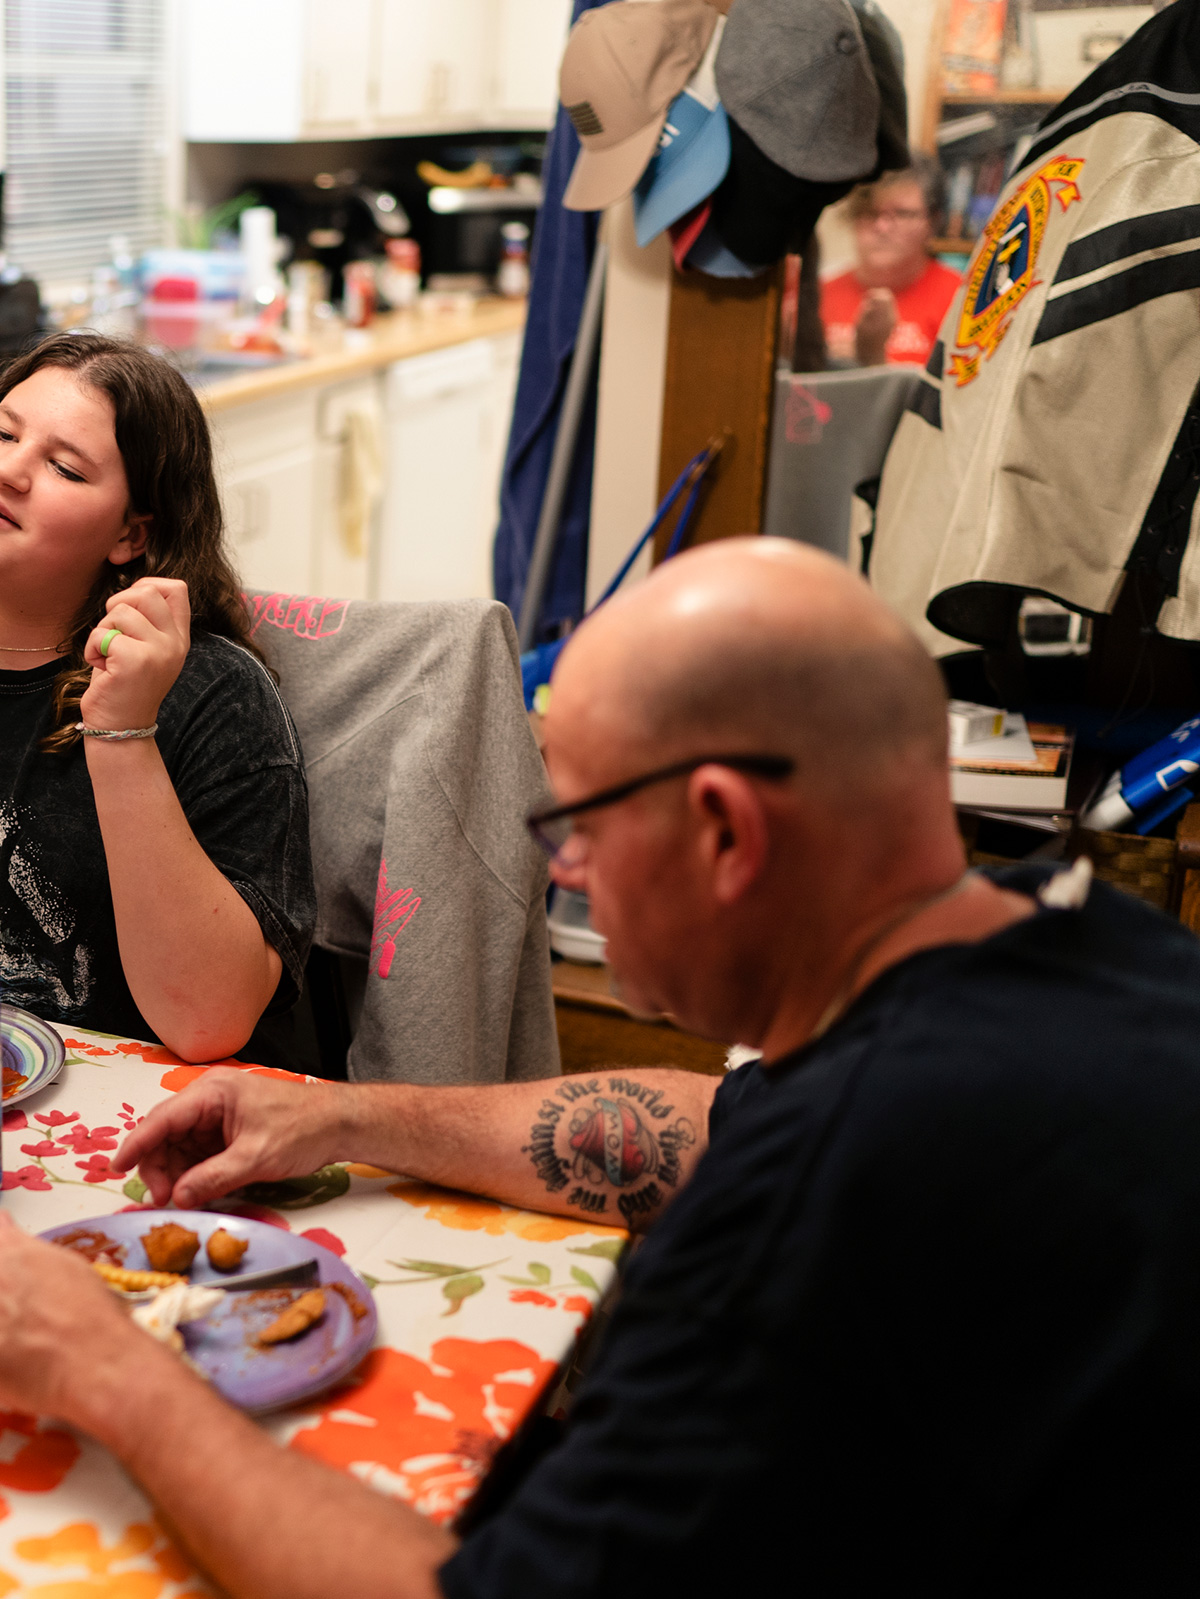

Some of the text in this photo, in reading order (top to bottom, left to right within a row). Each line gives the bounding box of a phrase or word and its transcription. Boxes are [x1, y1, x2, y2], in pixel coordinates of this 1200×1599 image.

[555, 1078, 603, 1103] the
[607, 1077, 675, 1119] world
[521, 1098, 571, 1193] against
[604, 1111, 622, 1174] MOM
[566, 1186, 608, 1214] me
[617, 1181, 664, 1224] and
